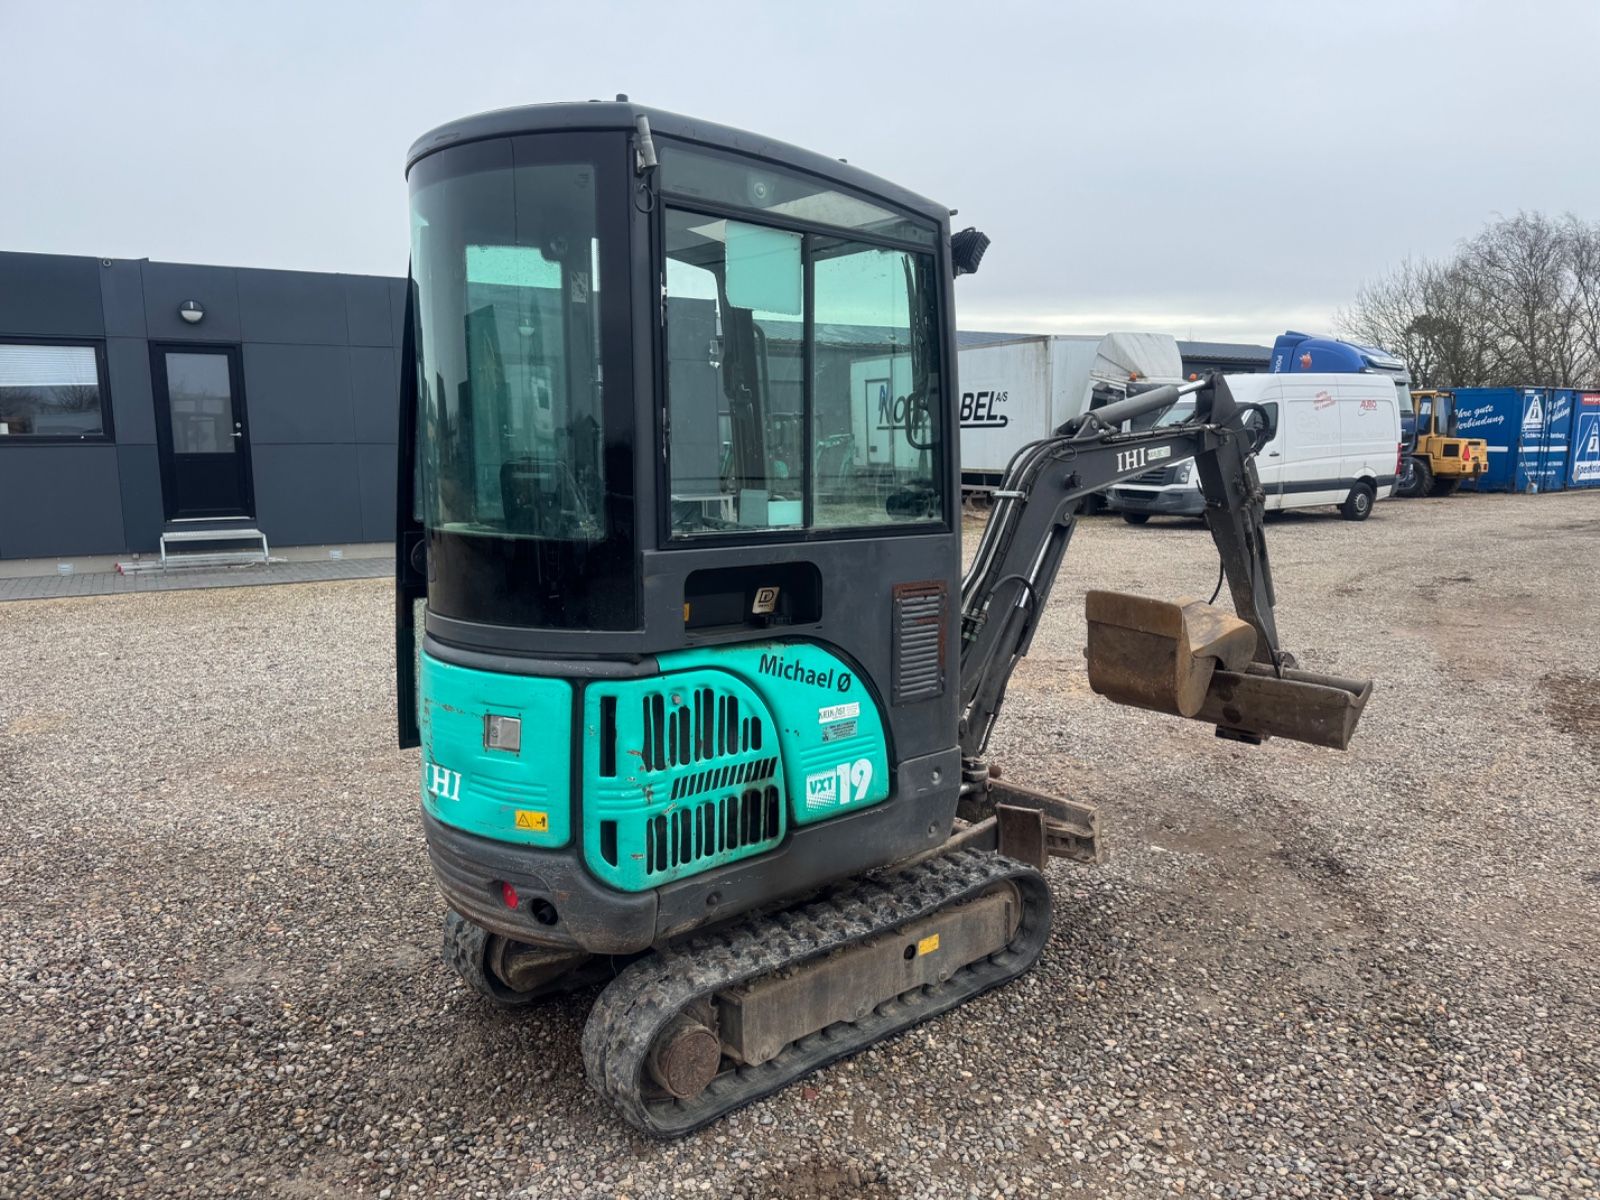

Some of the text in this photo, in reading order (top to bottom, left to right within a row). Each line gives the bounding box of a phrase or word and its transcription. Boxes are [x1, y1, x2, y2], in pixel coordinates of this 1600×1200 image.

[1474, 404, 1495, 418] gute
[1116, 447, 1147, 473] IHI
[758, 653, 852, 693] Michael Ø
[836, 758, 873, 805] 19
